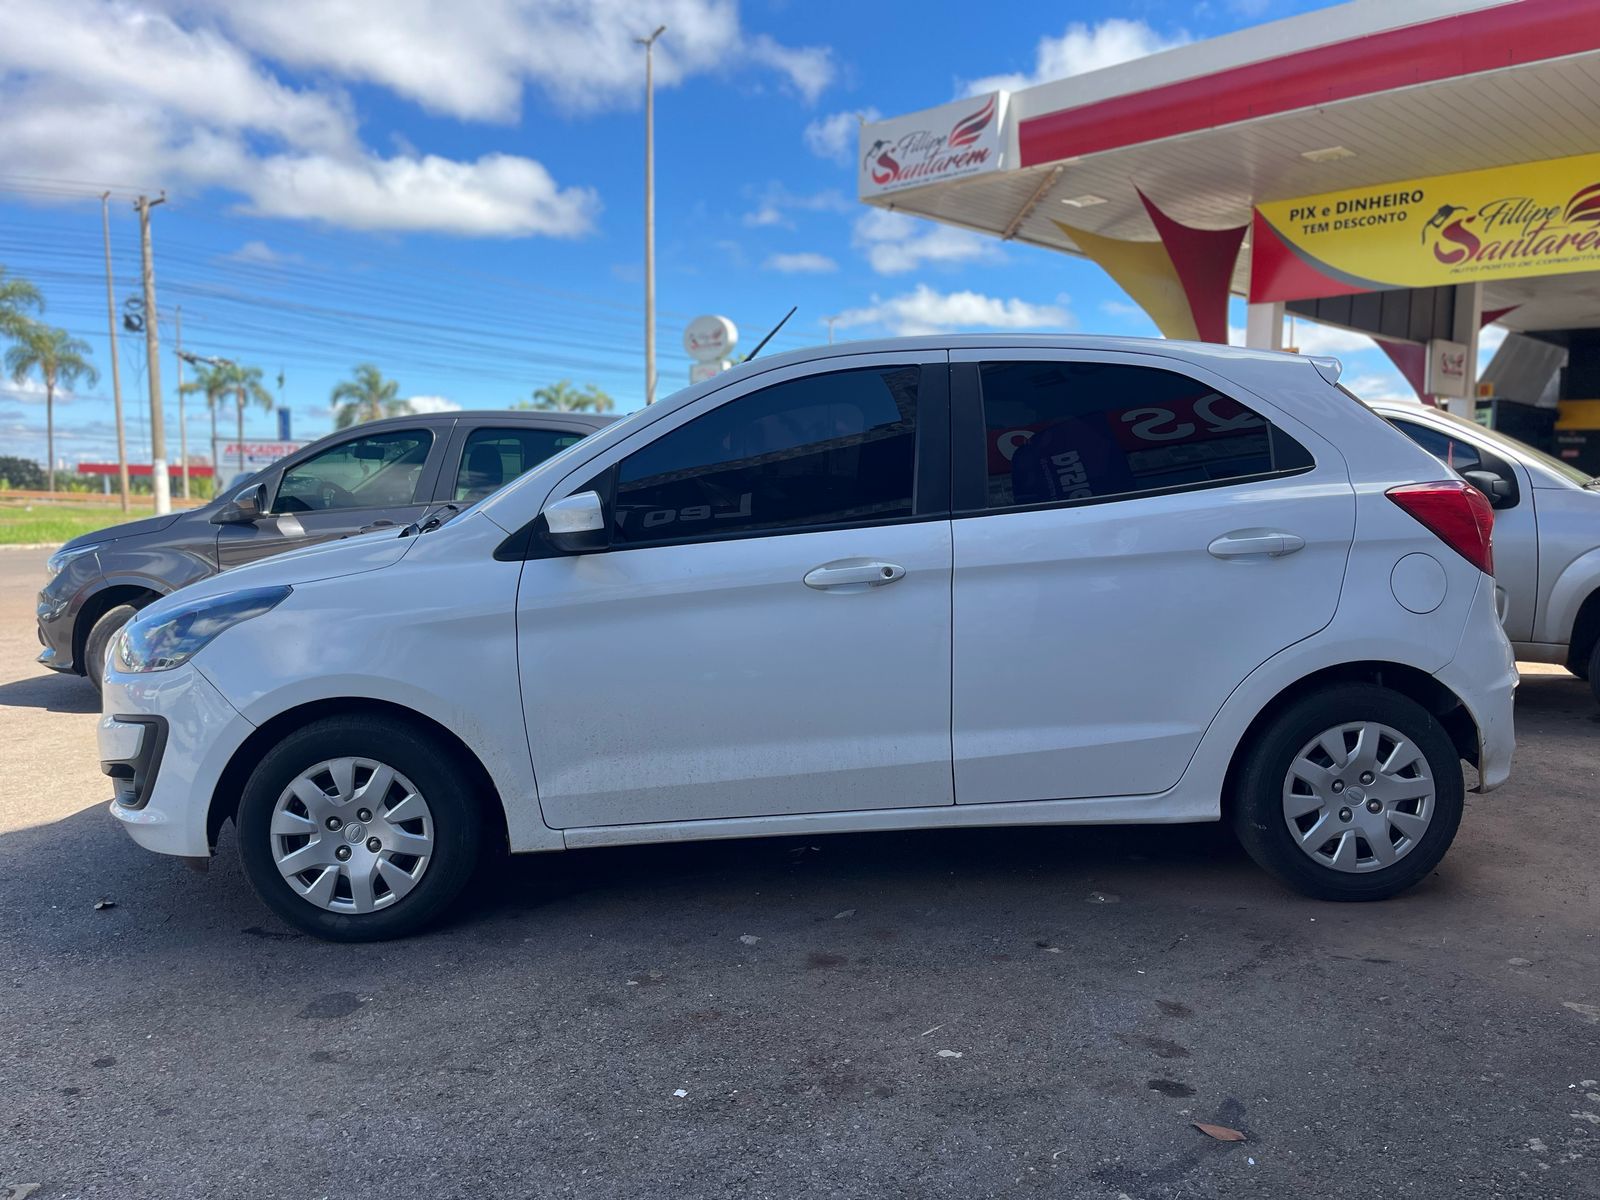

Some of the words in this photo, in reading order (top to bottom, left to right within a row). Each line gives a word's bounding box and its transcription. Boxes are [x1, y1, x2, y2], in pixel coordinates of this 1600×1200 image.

[1289, 206, 1316, 222] PIX
[1322, 207, 1331, 217] e
[1336, 189, 1424, 215] DINHEIRO
[1478, 197, 1561, 237] Fillipe
[1303, 222, 1329, 235] TEM
[1334, 211, 1407, 231] DESCONTO
